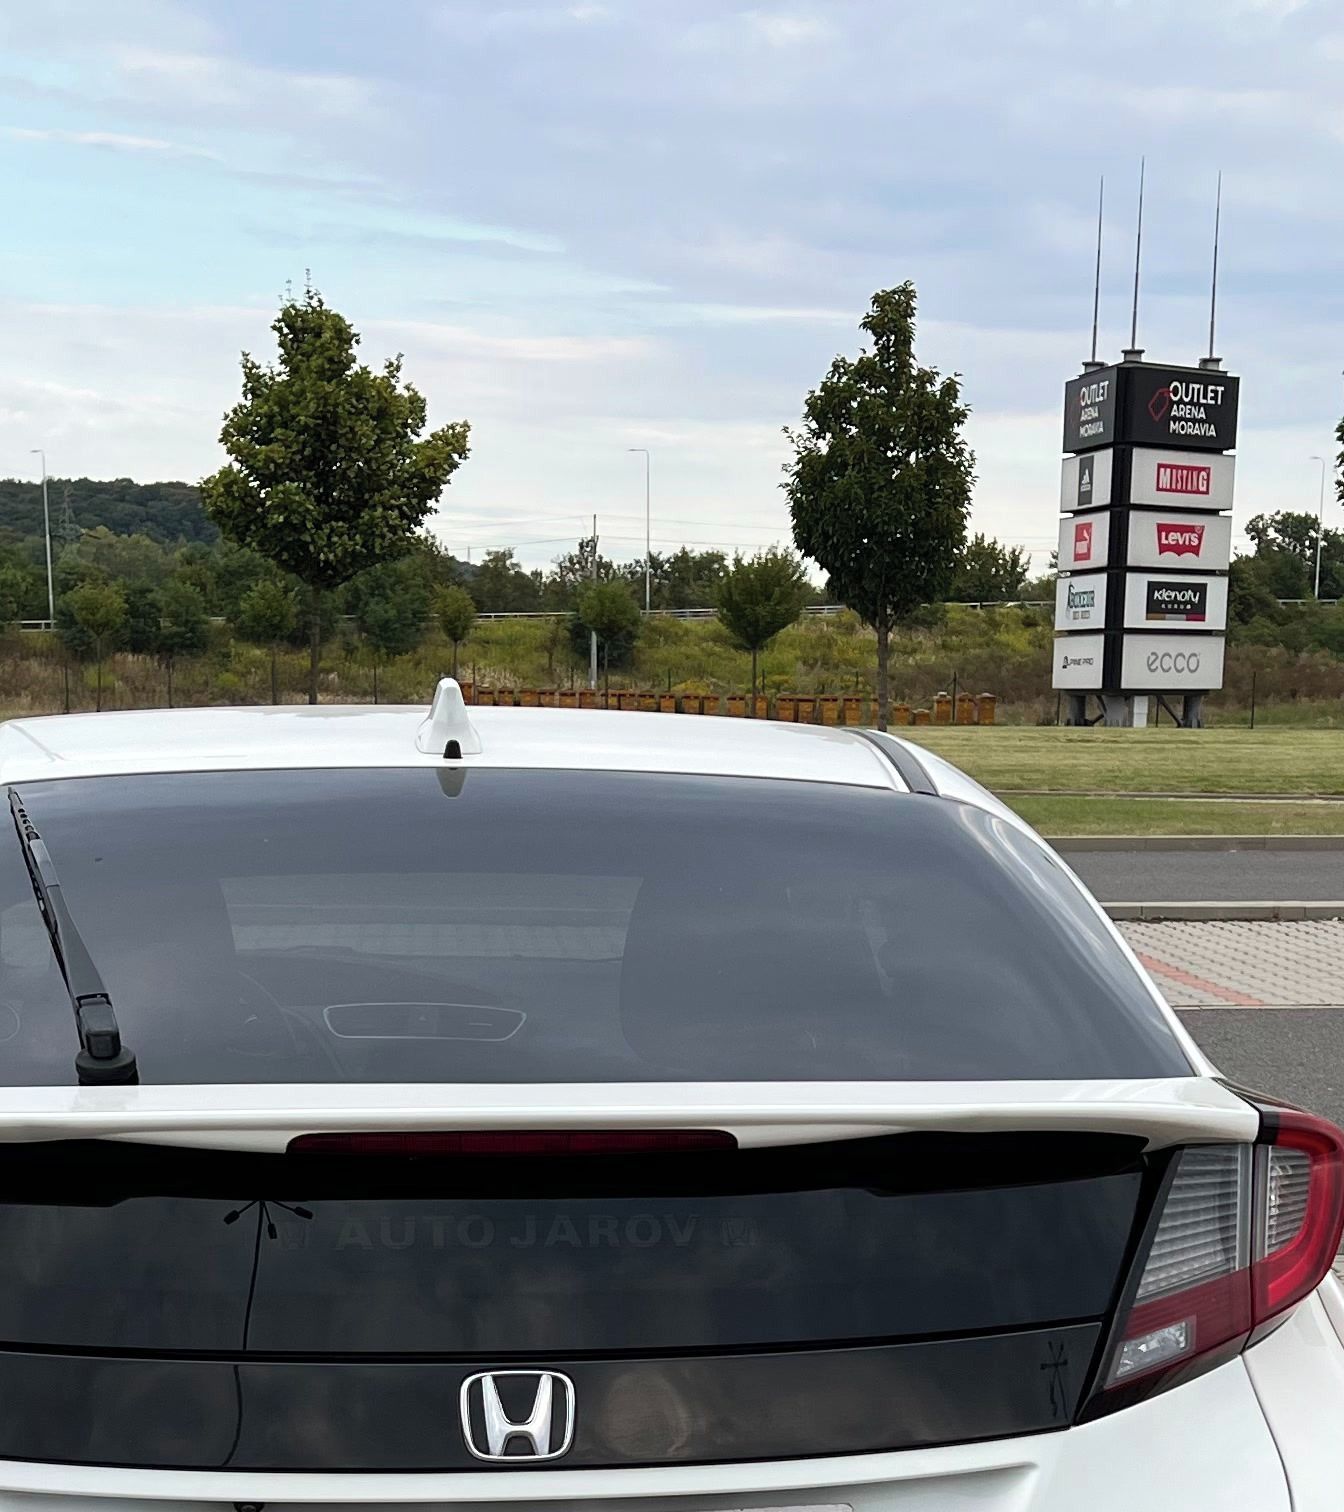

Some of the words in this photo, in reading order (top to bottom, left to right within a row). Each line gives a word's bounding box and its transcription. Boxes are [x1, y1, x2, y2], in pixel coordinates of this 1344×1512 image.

[1080, 380, 1109, 406] OUTLET
[1169, 381, 1225, 405] OUTLET
[1170, 405, 1206, 419] ARENA
[1169, 420, 1217, 437] MORAVIA
[1147, 652, 1200, 673] ecco
[336, 1213, 496, 1250] AUTO
[509, 1212, 700, 1248] JAROV
